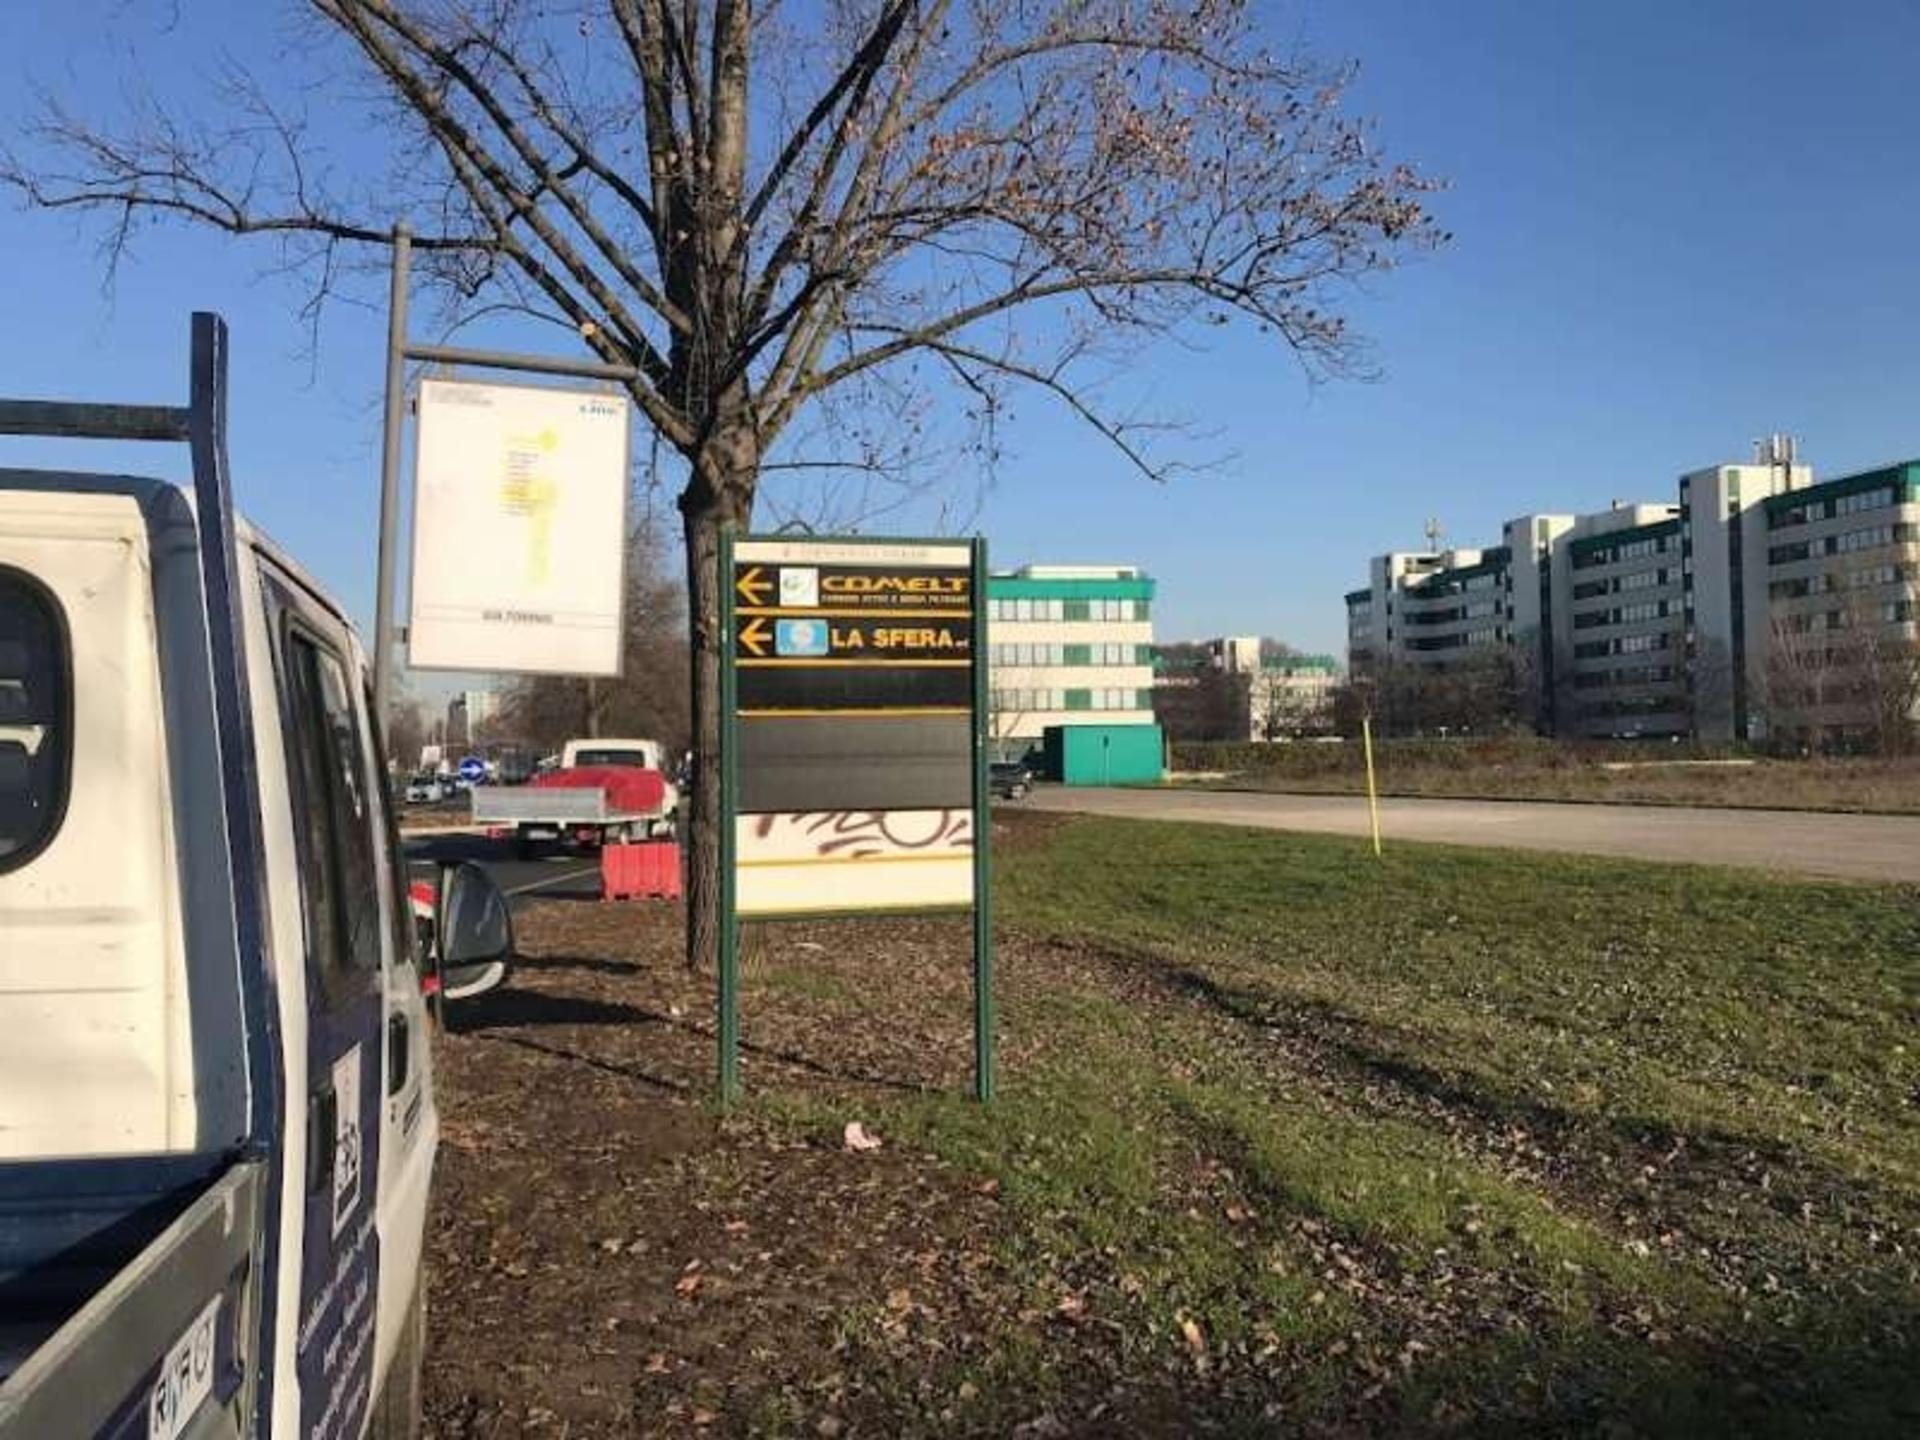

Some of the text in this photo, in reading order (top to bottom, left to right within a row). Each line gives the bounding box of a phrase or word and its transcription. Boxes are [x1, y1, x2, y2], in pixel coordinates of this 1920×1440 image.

[821, 575, 970, 592] COMELT
[831, 628, 864, 647] LA
[873, 628, 953, 648] SFERA
